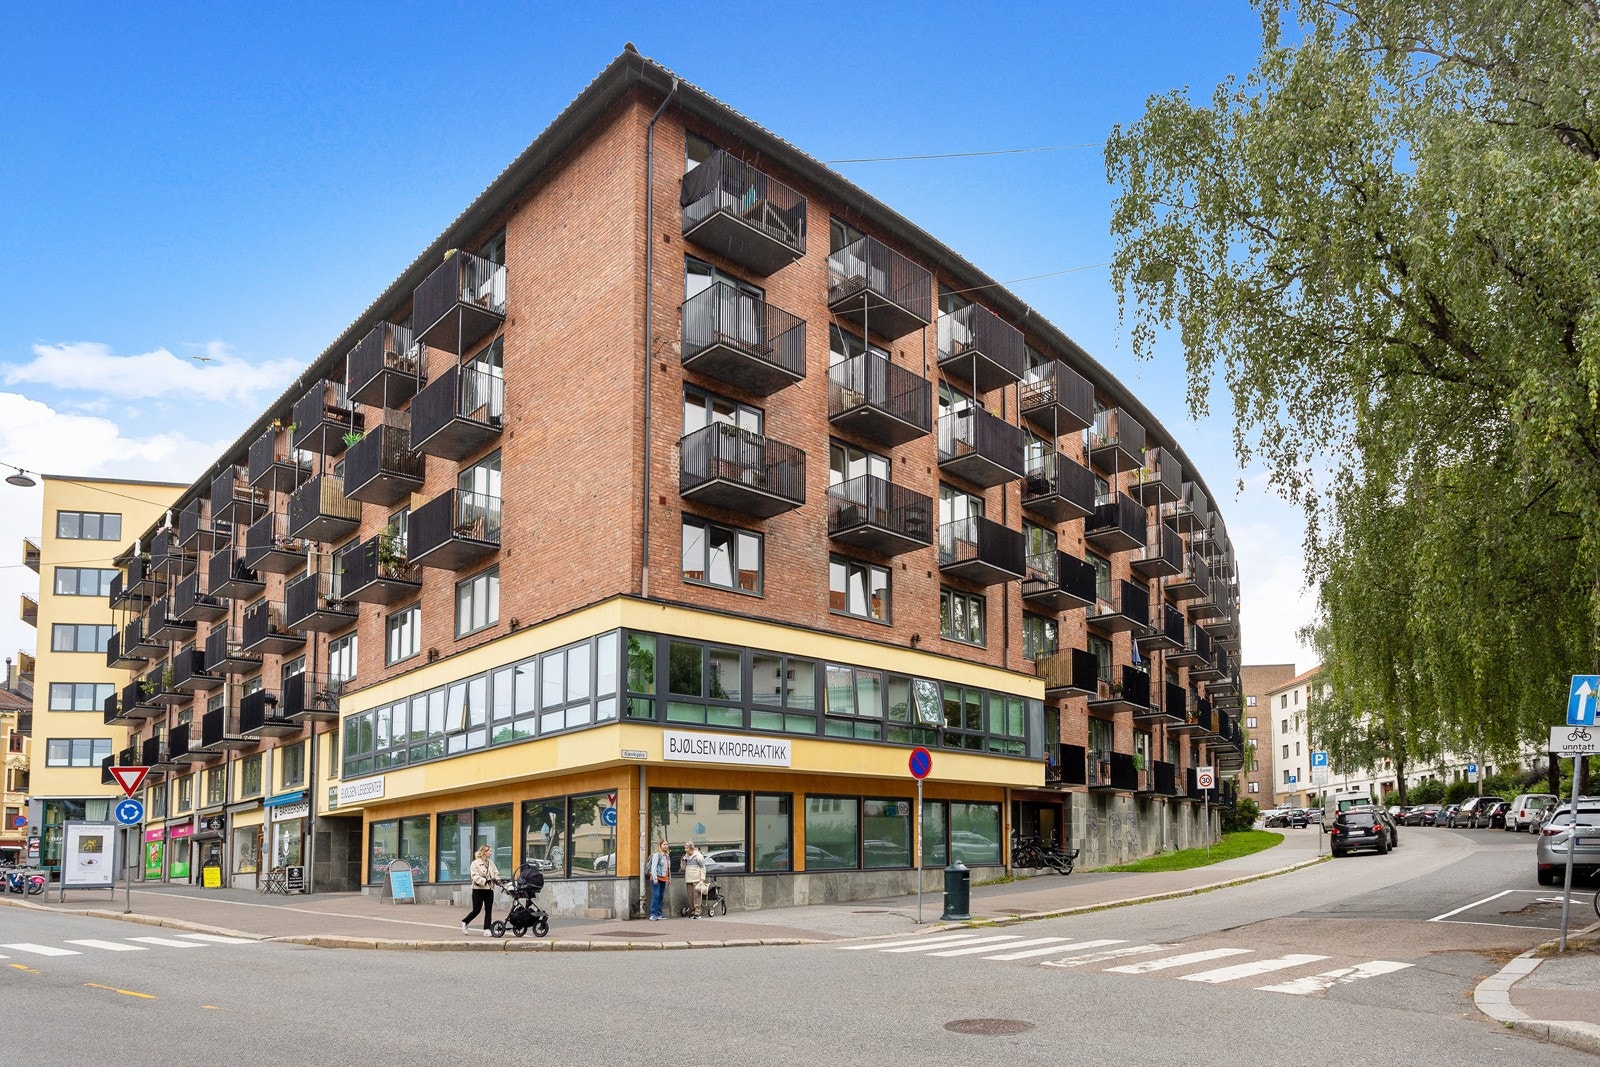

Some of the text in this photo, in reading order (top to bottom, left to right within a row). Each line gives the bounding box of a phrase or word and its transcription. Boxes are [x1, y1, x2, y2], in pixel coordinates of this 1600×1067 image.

[669, 737, 787, 760] BJØLSEN KIROPRAKTIKK
[1315, 754, 1324, 765] P
